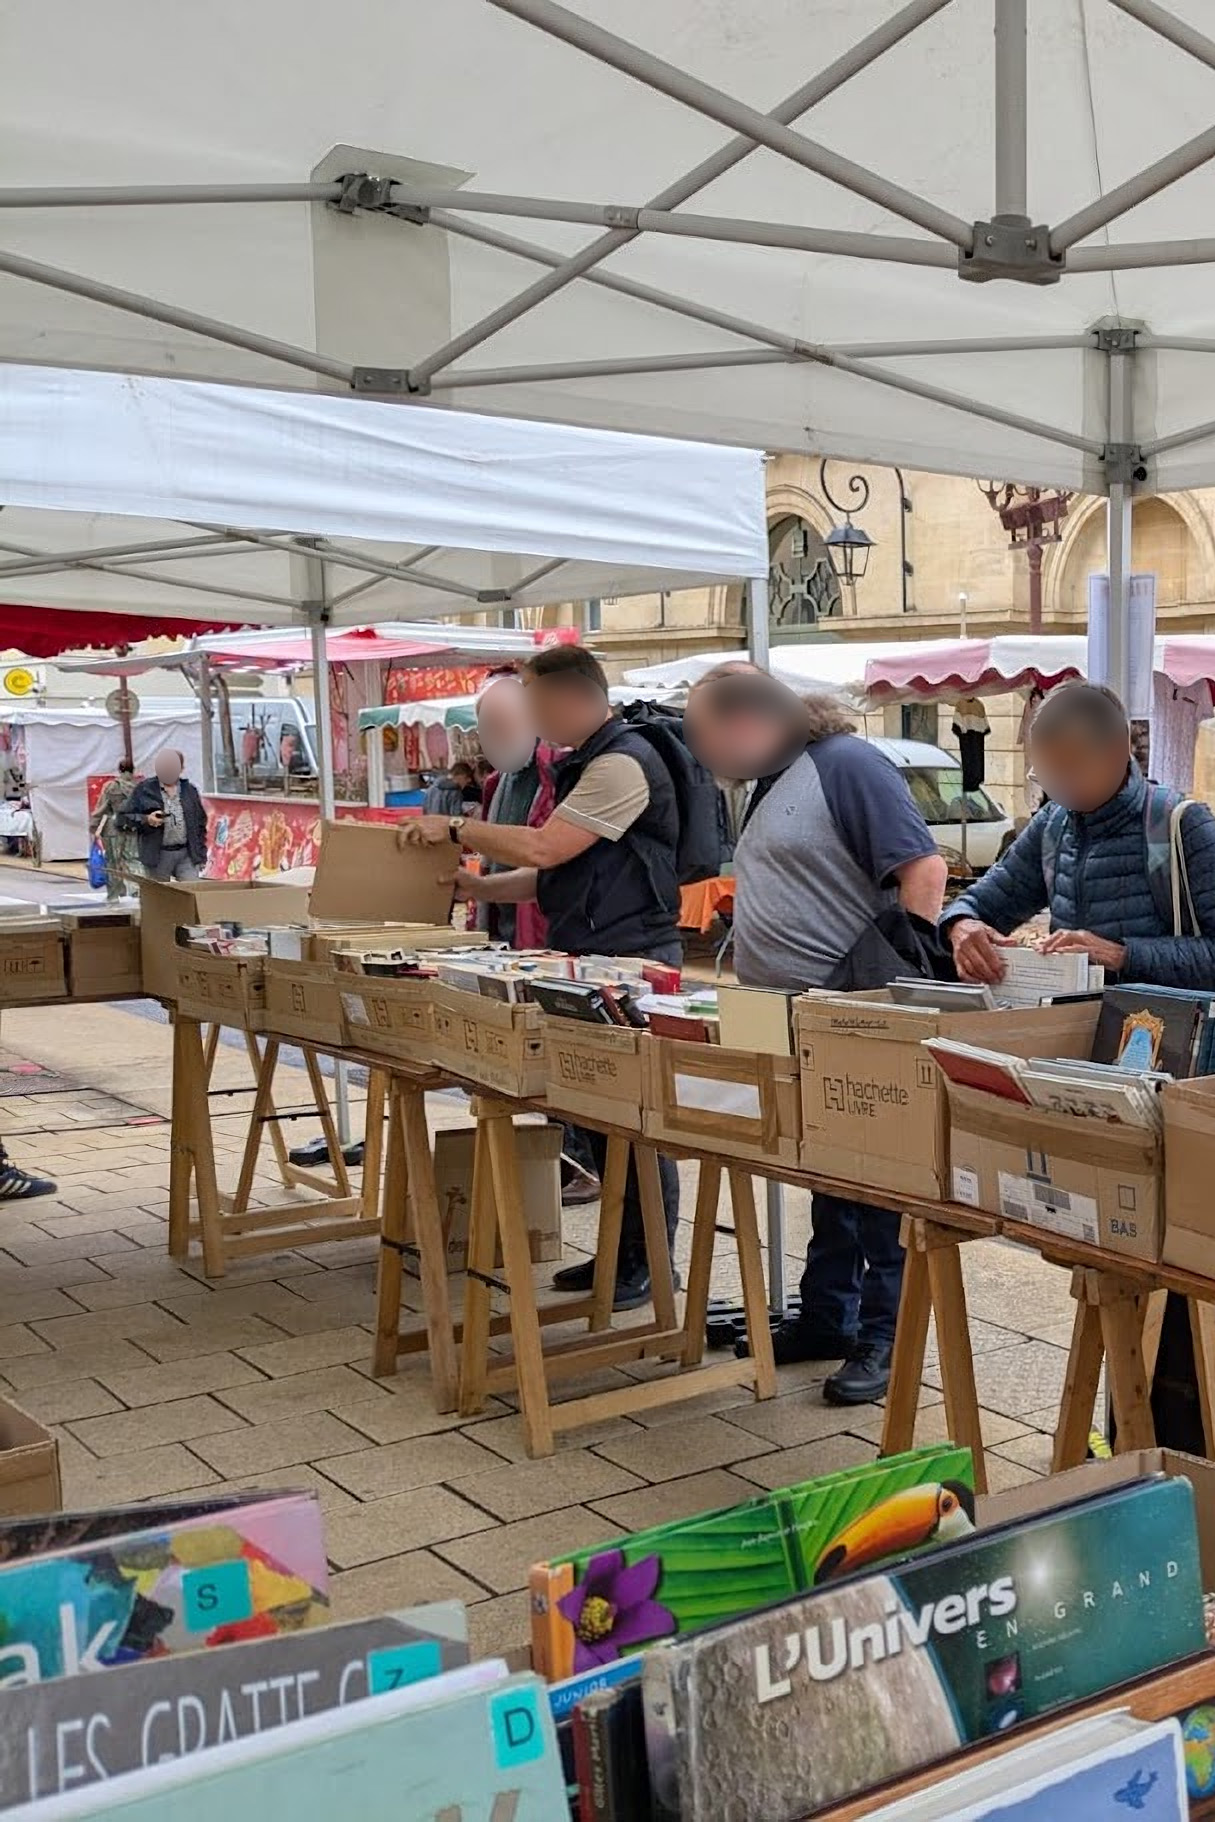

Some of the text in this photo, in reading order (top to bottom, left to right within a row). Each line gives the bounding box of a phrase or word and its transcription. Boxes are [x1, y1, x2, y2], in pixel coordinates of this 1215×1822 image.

[846, 1072, 910, 1106] hachette
[1109, 1218, 1137, 1238] BAS
[197, 1583, 219, 1611] S
[976, 1618, 1020, 1650] EN
[1053, 1560, 1178, 1620] GRAND
[755, 1576, 1017, 1704] L'Univers
[553, 1676, 609, 1706] JUNIOR
[28, 1712, 111, 1801] LES
[141, 1669, 320, 1769] GRATTE
[503, 1706, 536, 1749] D
